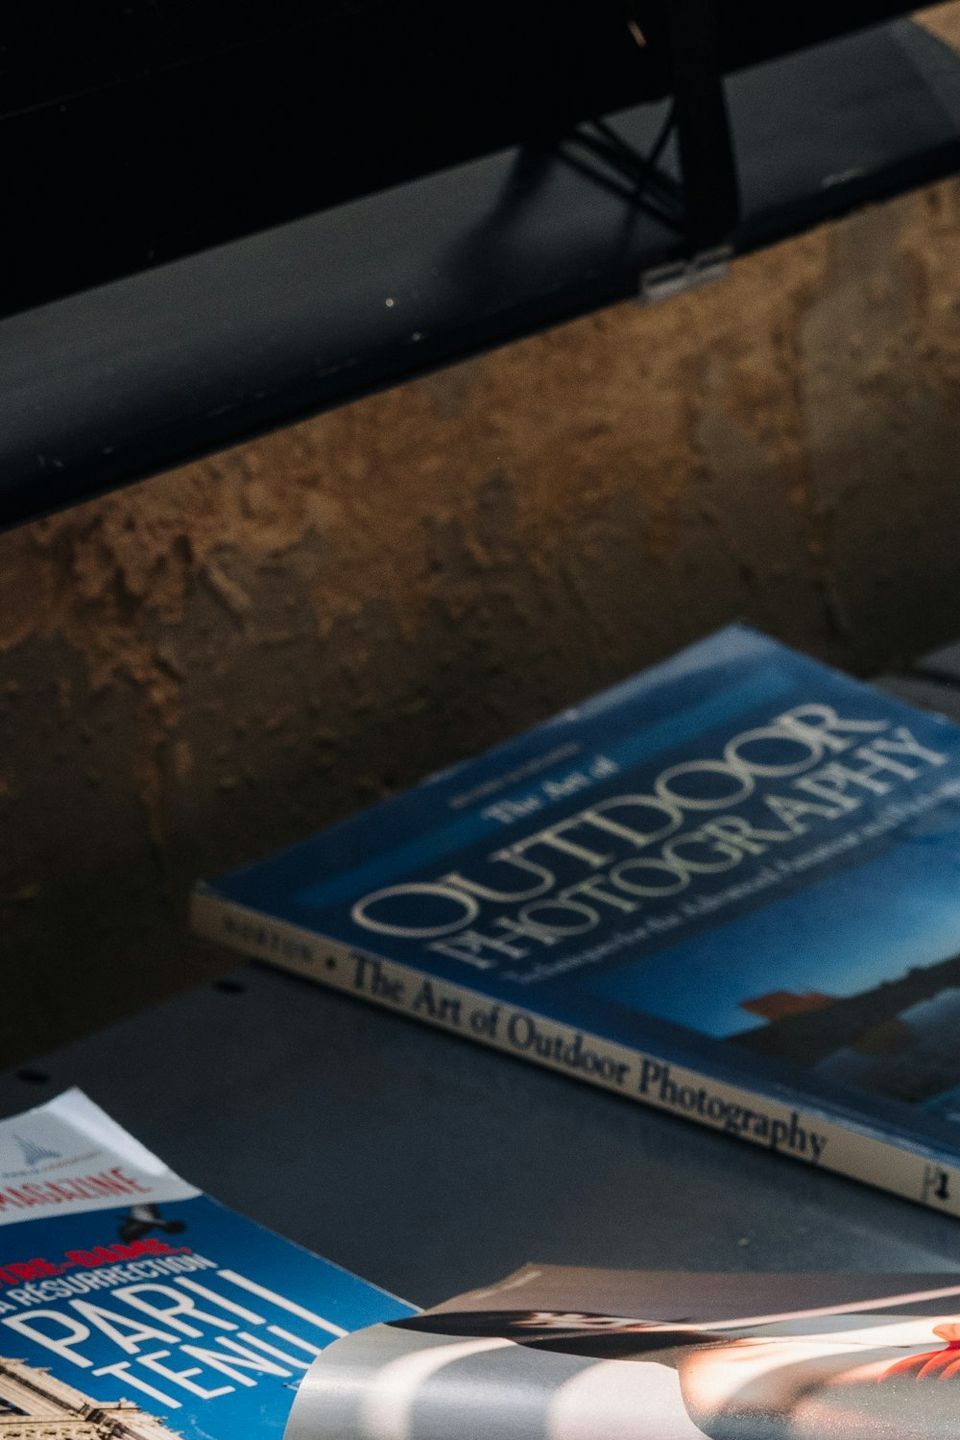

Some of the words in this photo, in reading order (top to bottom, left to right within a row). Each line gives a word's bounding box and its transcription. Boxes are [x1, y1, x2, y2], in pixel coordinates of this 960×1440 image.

[350, 700, 890, 940] OUTDOOR
[425, 724, 950, 972] PHOTOGRAPHY
[350, 951, 406, 999] The
[412, 978, 463, 1027] Art
[470, 1003, 502, 1037] of
[506, 1012, 632, 1086] Outdoor
[637, 1056, 829, 1166] Photography
[0, 1237, 193, 1289] TRE-DAME,
[6, 1253, 219, 1307] RÉSURRECTION
[91, 1325, 323, 1410] TENU
